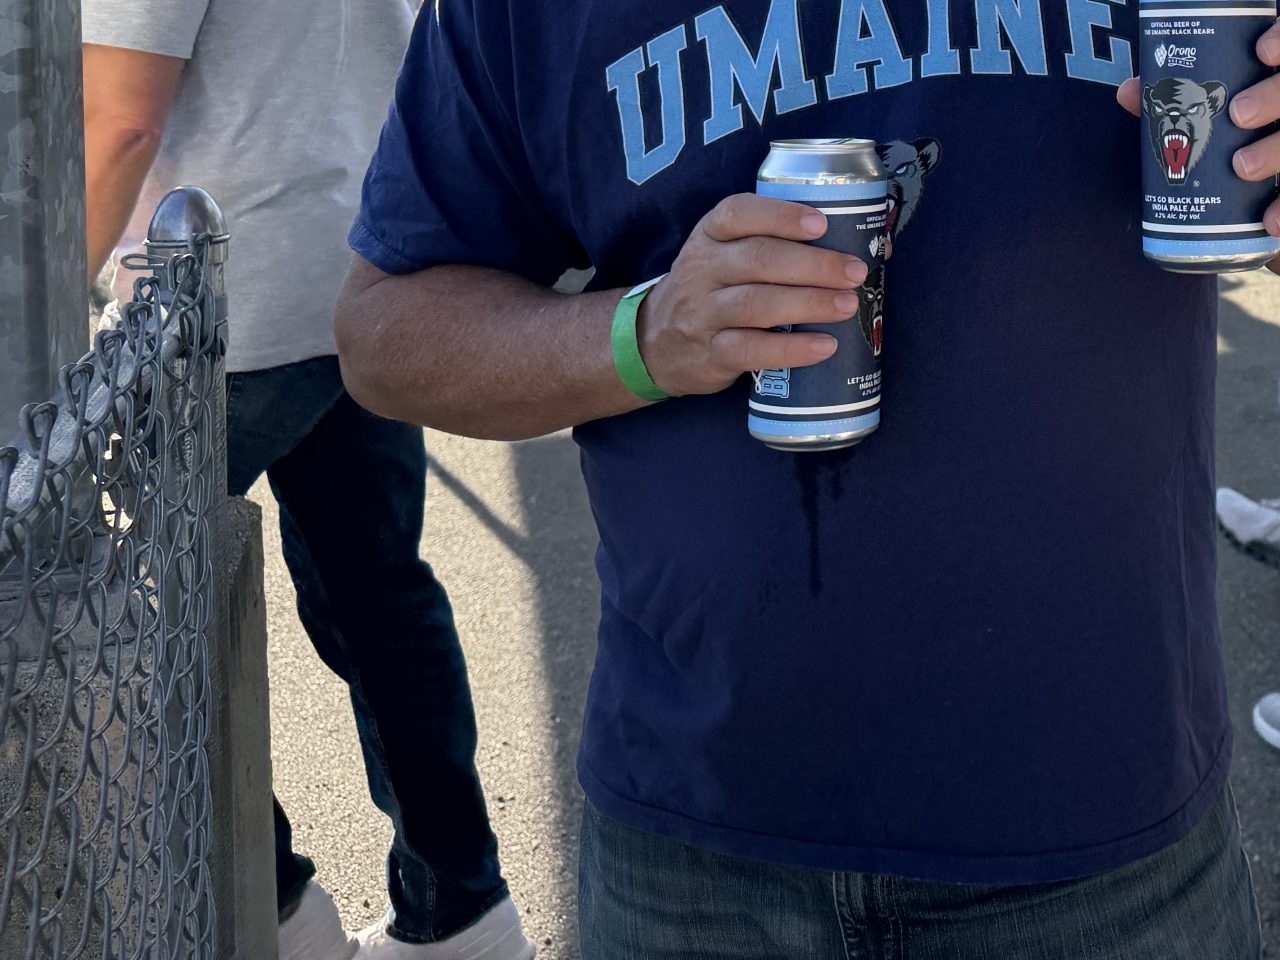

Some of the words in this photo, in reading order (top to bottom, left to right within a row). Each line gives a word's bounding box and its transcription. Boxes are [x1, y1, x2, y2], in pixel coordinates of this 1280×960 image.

[1167, 44, 1197, 58] Orono
[1144, 194, 1157, 202] LET'S
[1167, 196, 1192, 204] BLACK
[1193, 196, 1222, 204] BEARS
[1151, 203, 1168, 211] INDIA
[1169, 204, 1188, 212] PALE
[1189, 204, 1206, 212] ALE
[1178, 213, 1187, 221] by
[847, 376, 864, 385] LET'S
